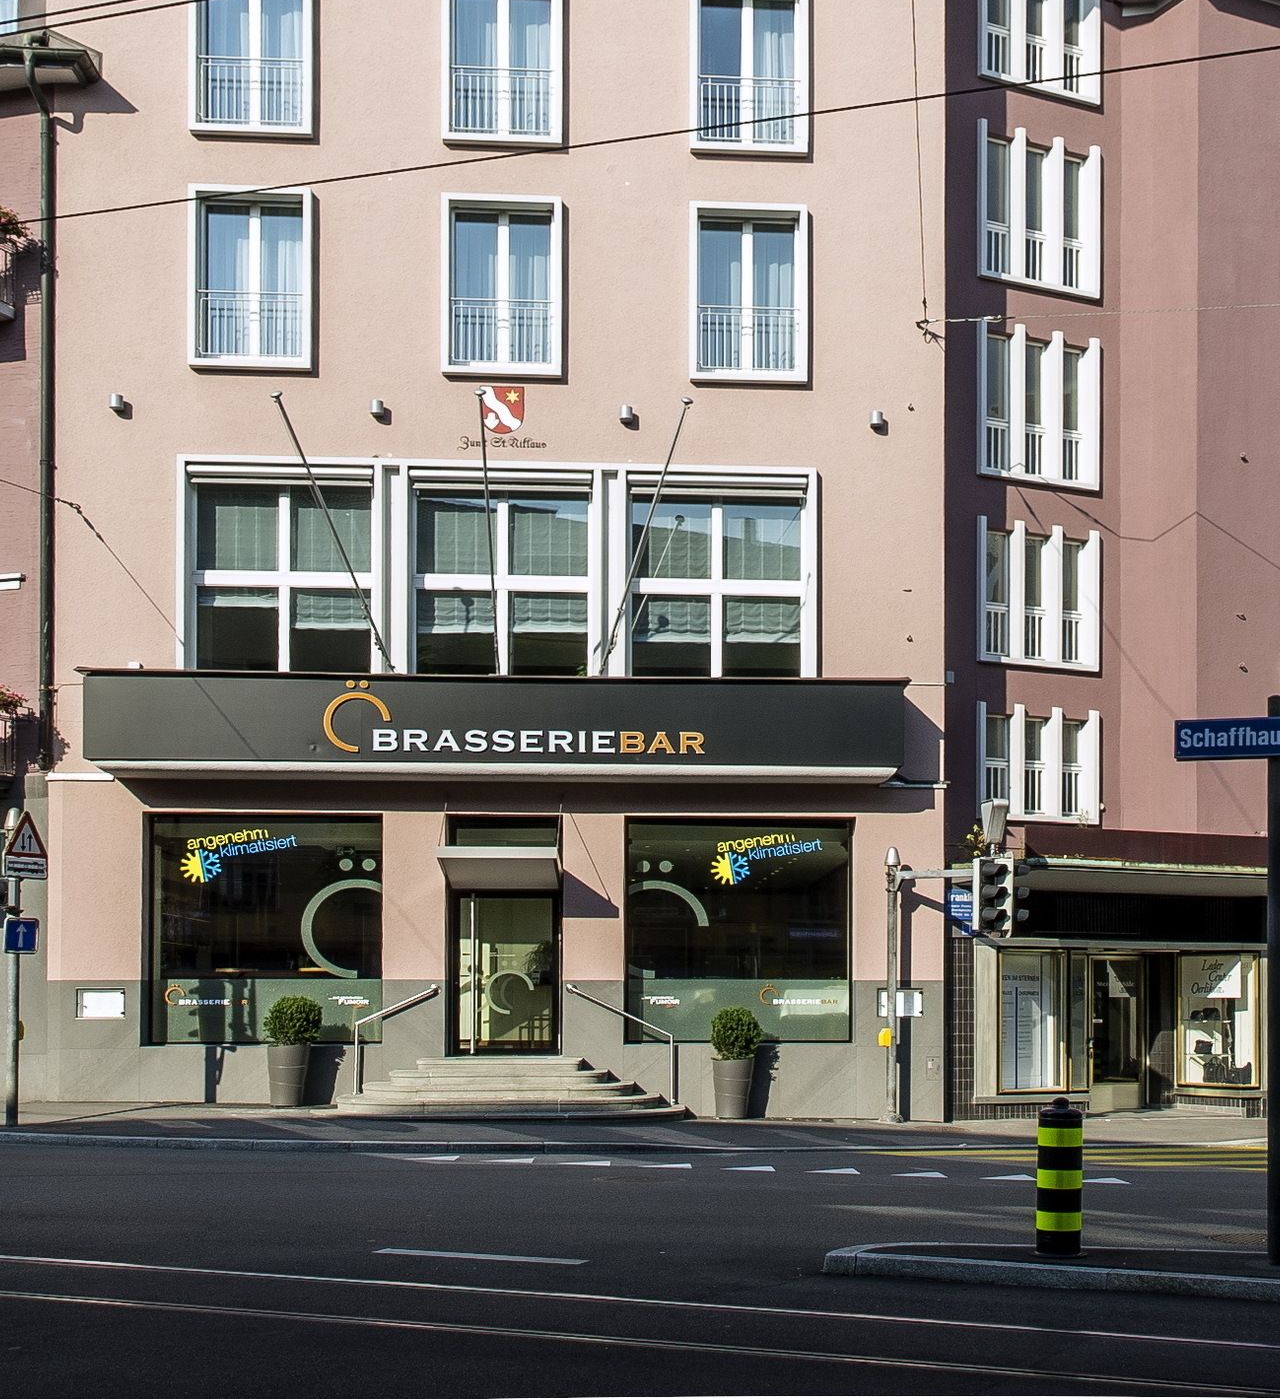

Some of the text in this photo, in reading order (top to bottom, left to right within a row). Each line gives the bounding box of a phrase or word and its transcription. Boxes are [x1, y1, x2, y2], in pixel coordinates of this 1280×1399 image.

[186, 828, 270, 850] angenehm
[220, 834, 298, 858] klimatisiert
[747, 838, 823, 860] klimatisiert
